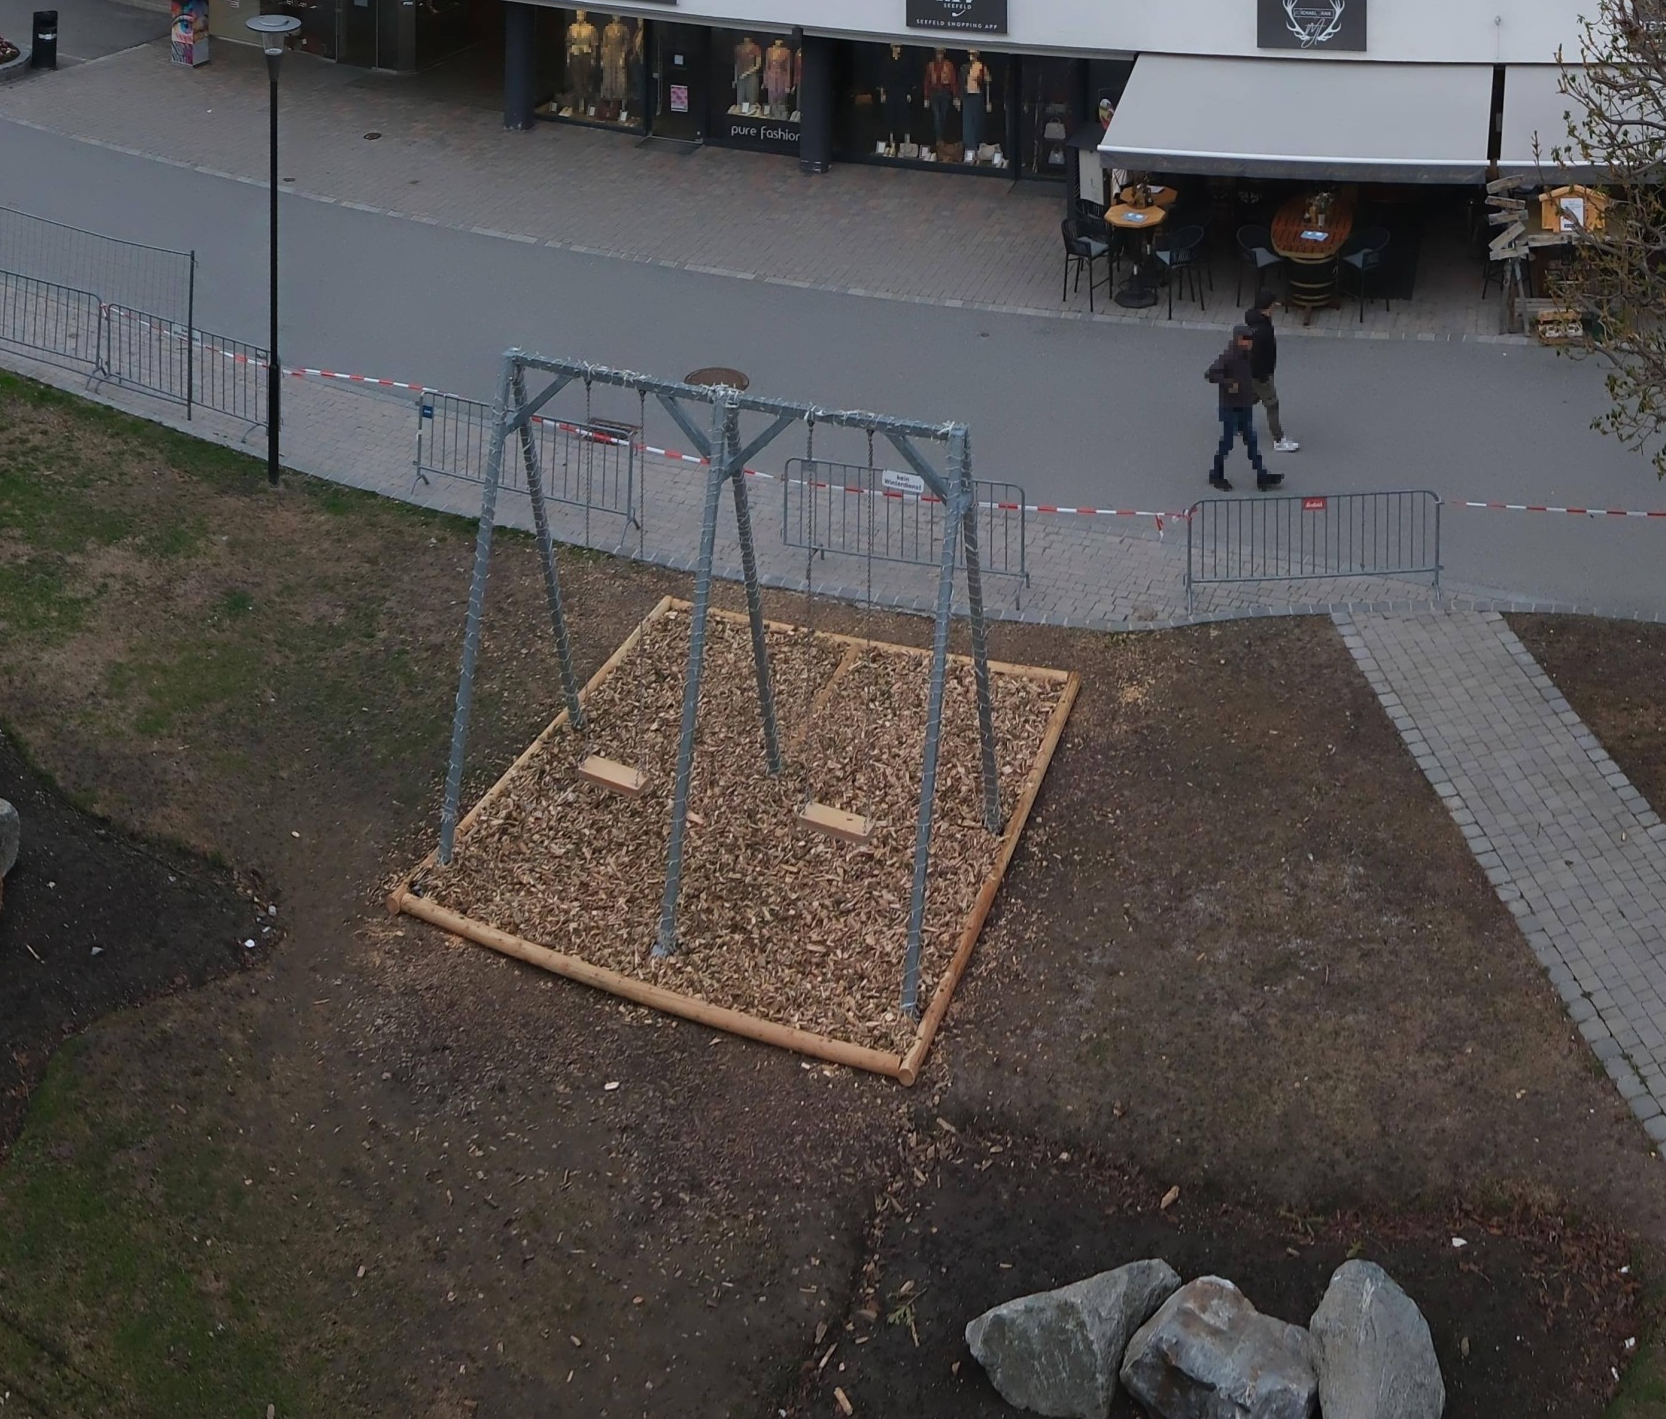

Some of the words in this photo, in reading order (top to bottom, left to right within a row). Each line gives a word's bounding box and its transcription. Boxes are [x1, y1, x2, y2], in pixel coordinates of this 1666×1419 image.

[916, 18, 945, 26] SEEFELD
[947, 21, 982, 29] SHOPPING
[730, 125, 757, 136] pure
[896, 473, 910, 482] kein
[884, 478, 922, 491] Winterdienst
